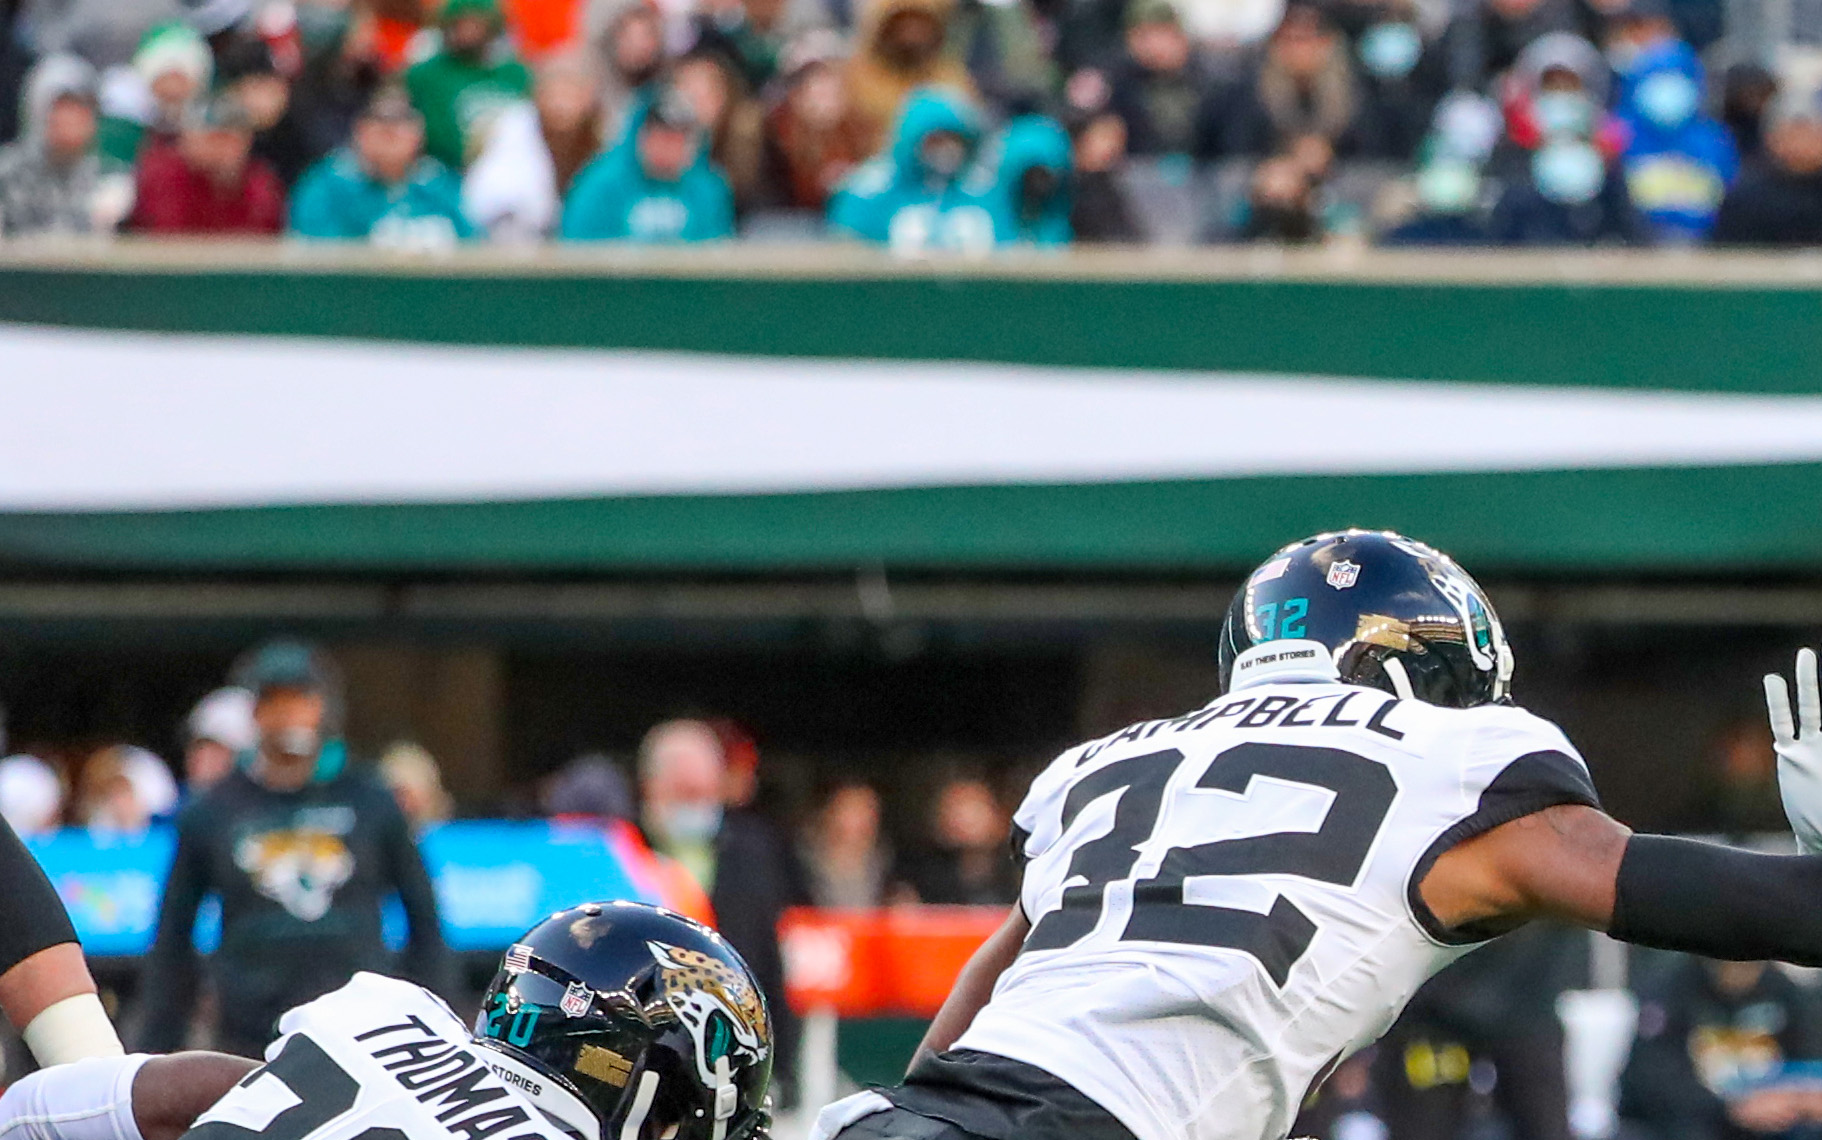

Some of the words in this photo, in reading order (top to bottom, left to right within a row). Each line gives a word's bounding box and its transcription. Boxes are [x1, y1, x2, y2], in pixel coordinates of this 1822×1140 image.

[1331, 571, 1354, 585] NFL
[1252, 597, 1310, 646] 32
[1255, 653, 1277, 665] THEIR
[1279, 649, 1316, 661] STORIES
[1020, 741, 1400, 990] 32
[486, 991, 542, 1049] 20
[564, 996, 586, 1014] NFL
[490, 1063, 543, 1096] STORIES
